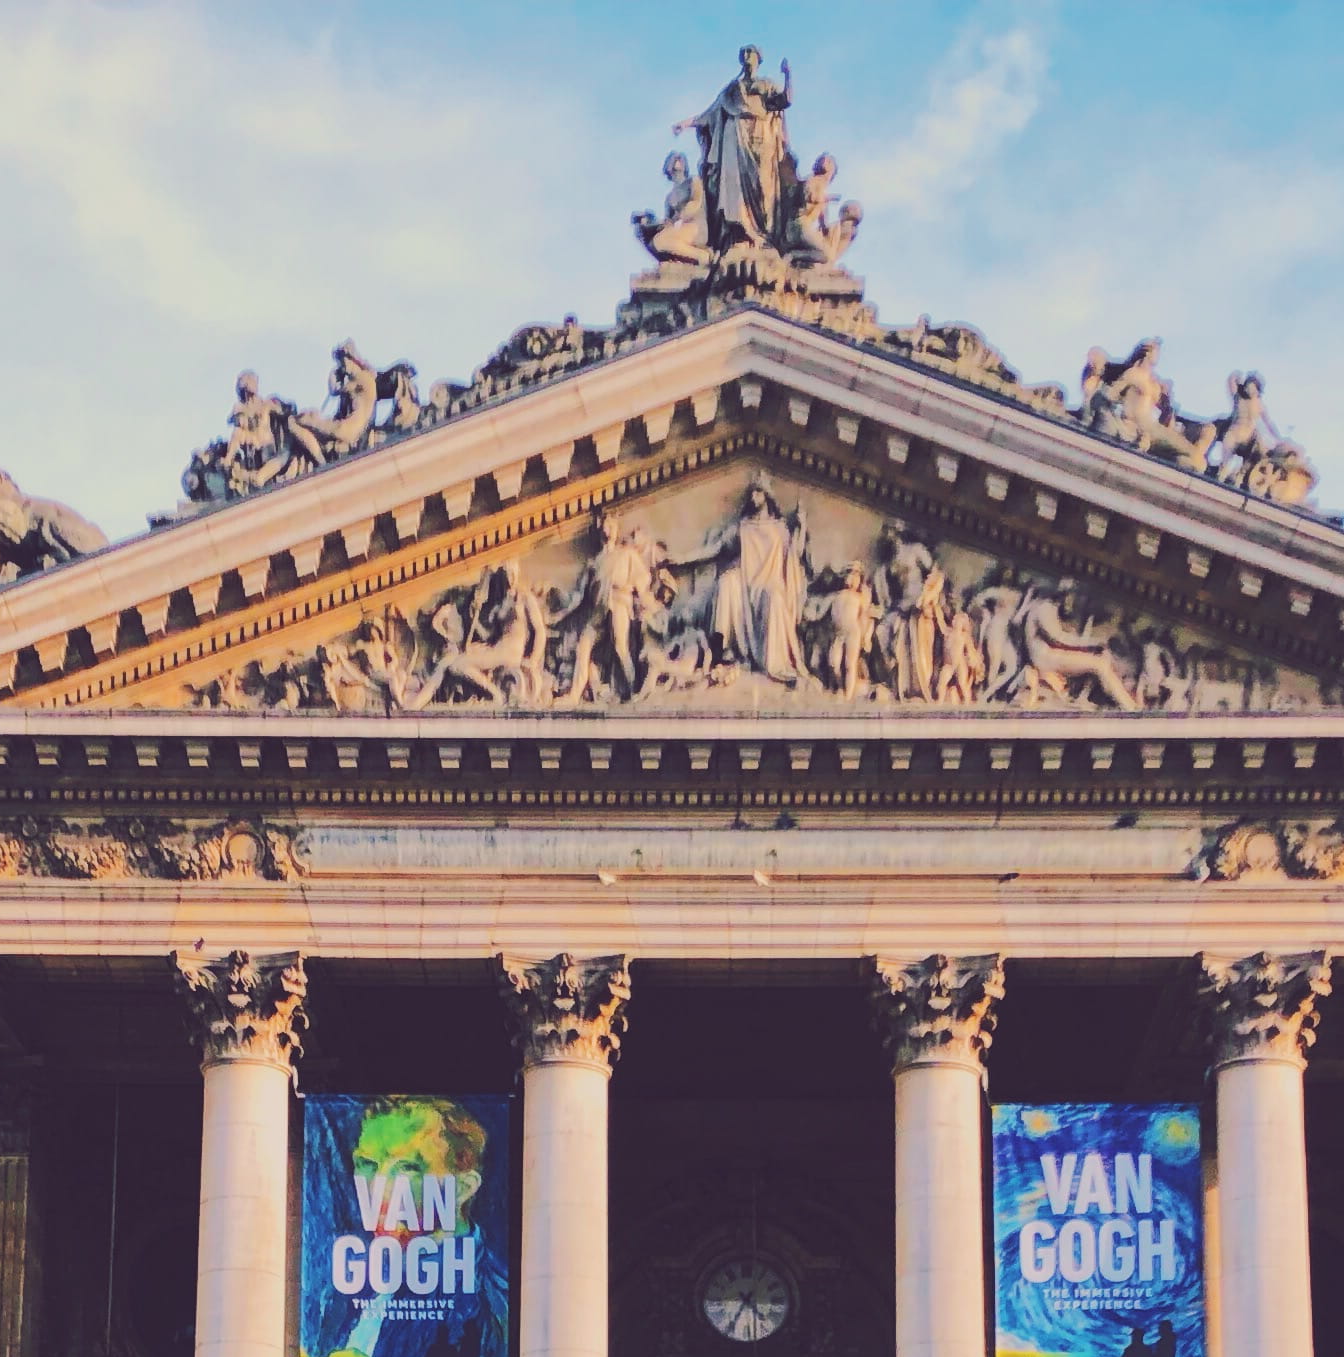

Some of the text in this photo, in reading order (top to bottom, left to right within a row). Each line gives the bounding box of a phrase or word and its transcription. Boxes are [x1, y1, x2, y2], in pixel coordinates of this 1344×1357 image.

[353, 1173, 456, 1232] VAN
[1040, 1152, 1153, 1215] VAN
[332, 1235, 476, 1295] GOGH
[1019, 1218, 1176, 1284] GOGH
[352, 1299, 455, 1309] THE IMMERSIVE
[361, 1311, 444, 1320] EXPERIENCE
